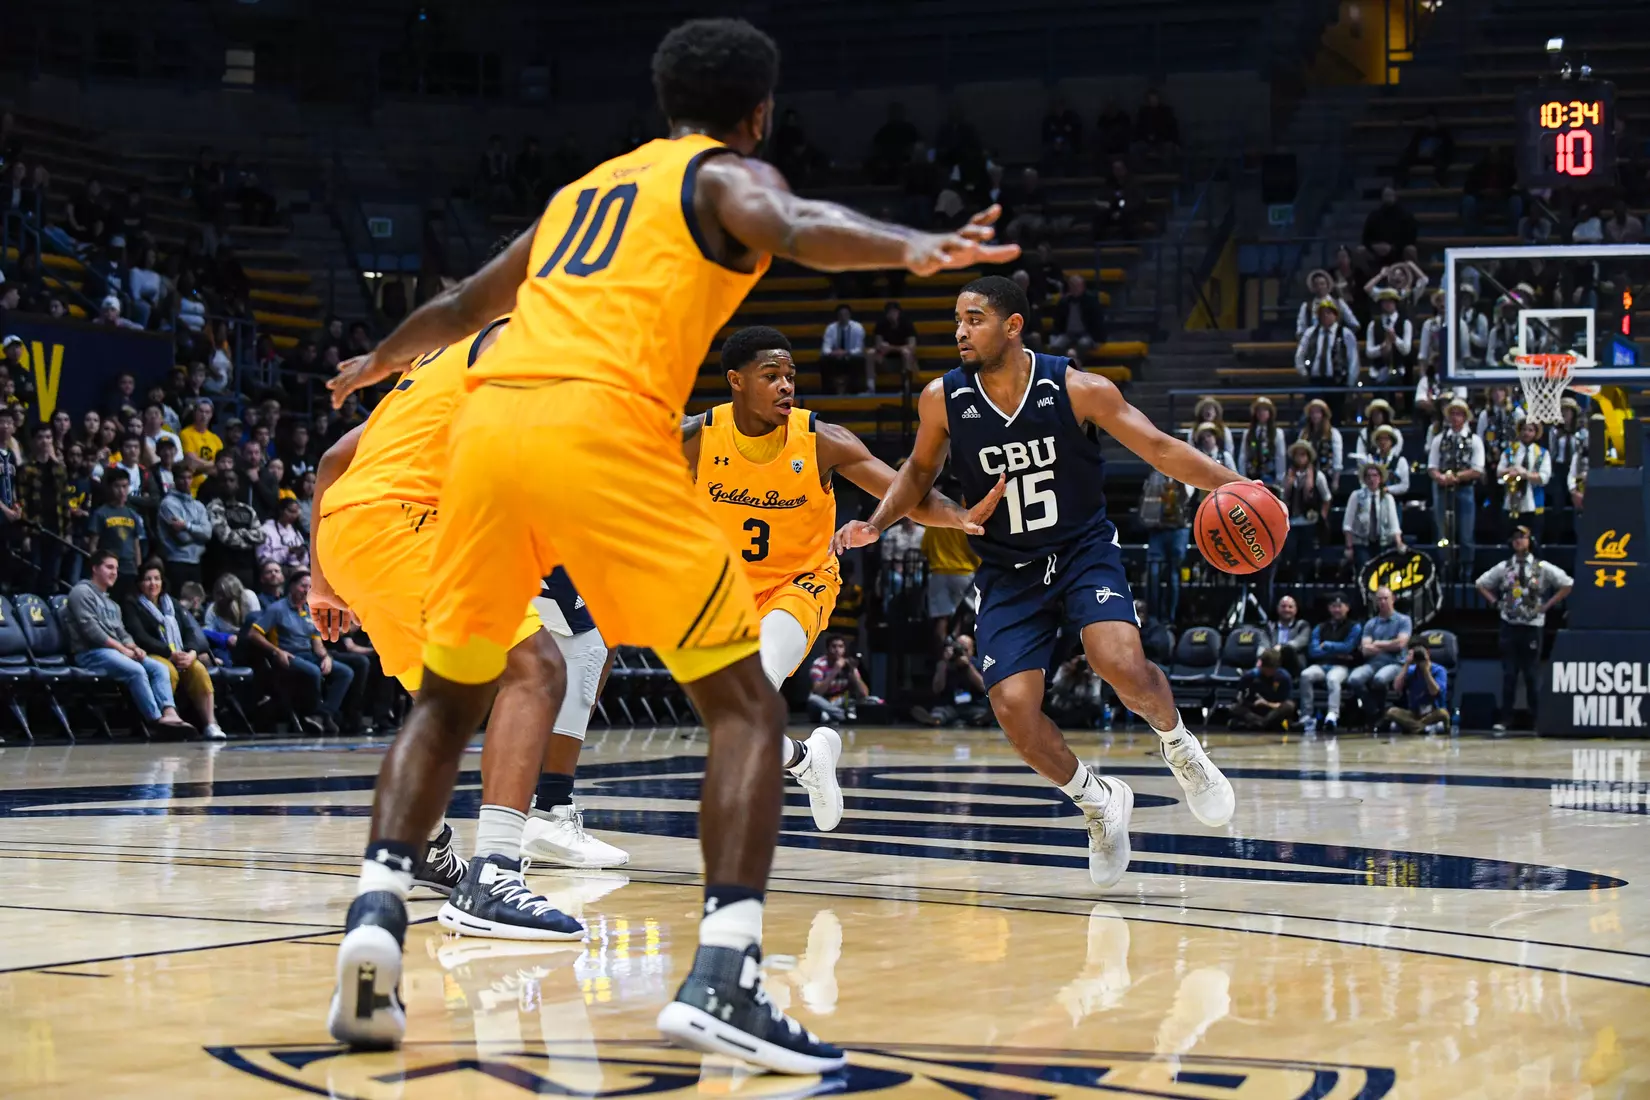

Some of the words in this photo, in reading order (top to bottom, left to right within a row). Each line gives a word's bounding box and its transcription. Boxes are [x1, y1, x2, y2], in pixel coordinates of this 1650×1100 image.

[1541, 101, 1599, 129] 10:34
[1556, 129, 1593, 176] 10
[536, 182, 638, 277] 10
[978, 436, 1057, 476] CBU
[708, 482, 760, 505] Golden
[762, 490, 806, 507] Bears
[1003, 470, 1058, 534] 15
[742, 517, 770, 563] 3
[1228, 504, 1266, 561] Wilson
[1594, 529, 1631, 558] Cal
[792, 572, 826, 600] Cal
[1368, 555, 1424, 592] Cal
[1552, 661, 1650, 693] MUSCL
[1573, 695, 1642, 726] MILK
